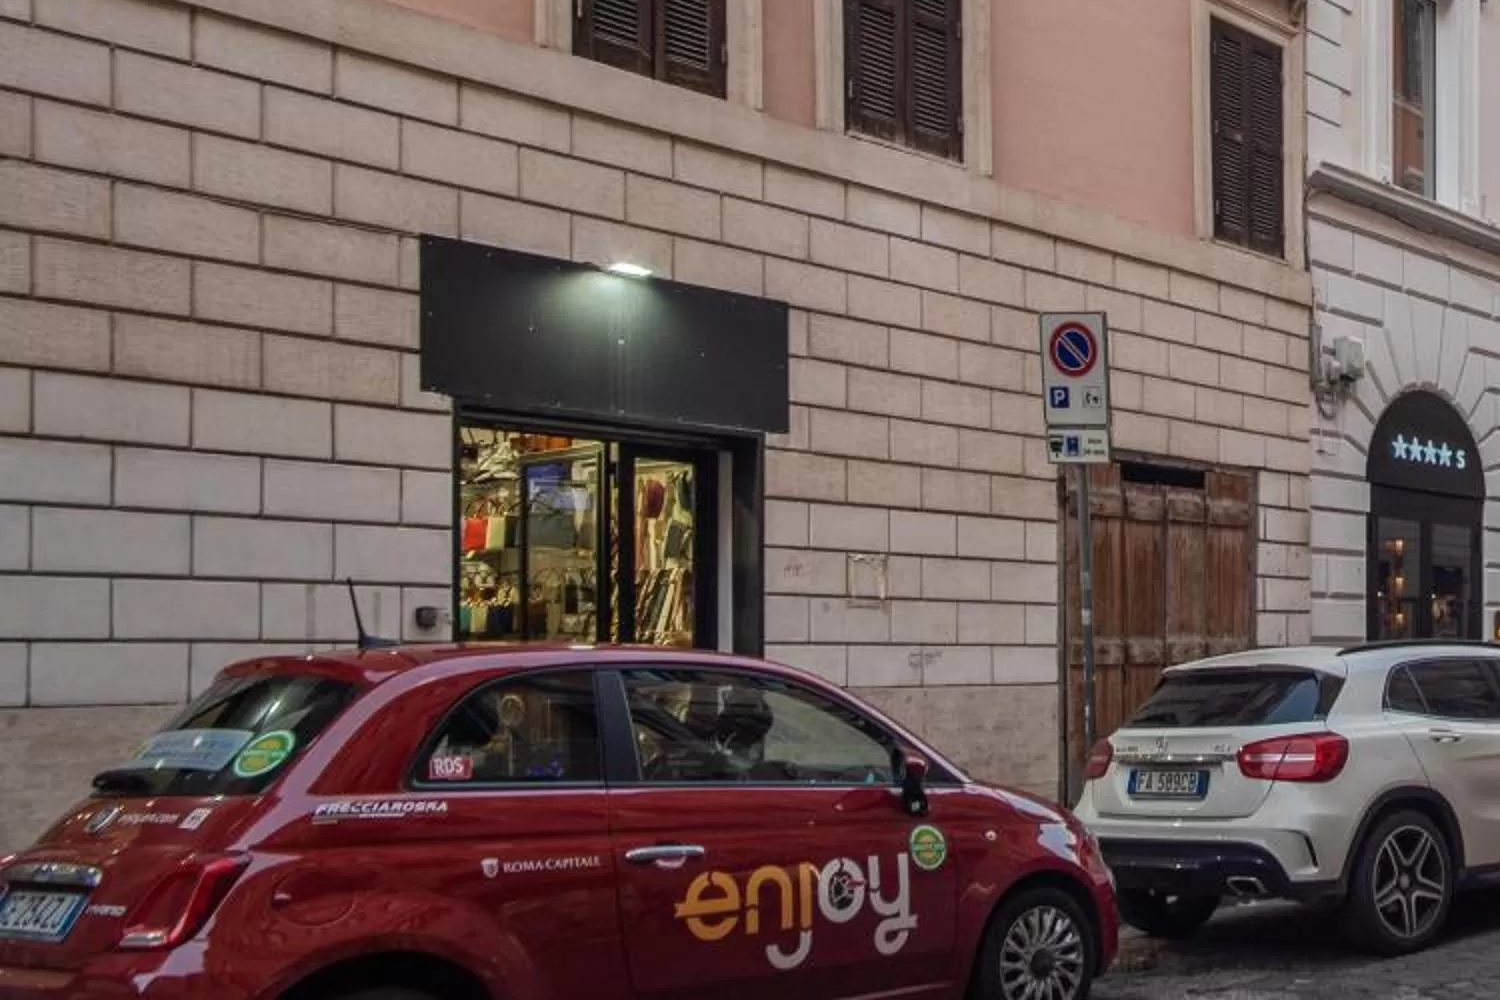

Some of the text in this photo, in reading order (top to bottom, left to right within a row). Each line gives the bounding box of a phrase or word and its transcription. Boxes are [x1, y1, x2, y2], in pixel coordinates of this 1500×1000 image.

[1053, 390, 1066, 405] P
[434, 756, 464, 775] RDS
[503, 855, 601, 873] ROMA CAPITALE
[674, 852, 918, 970] enjoy
